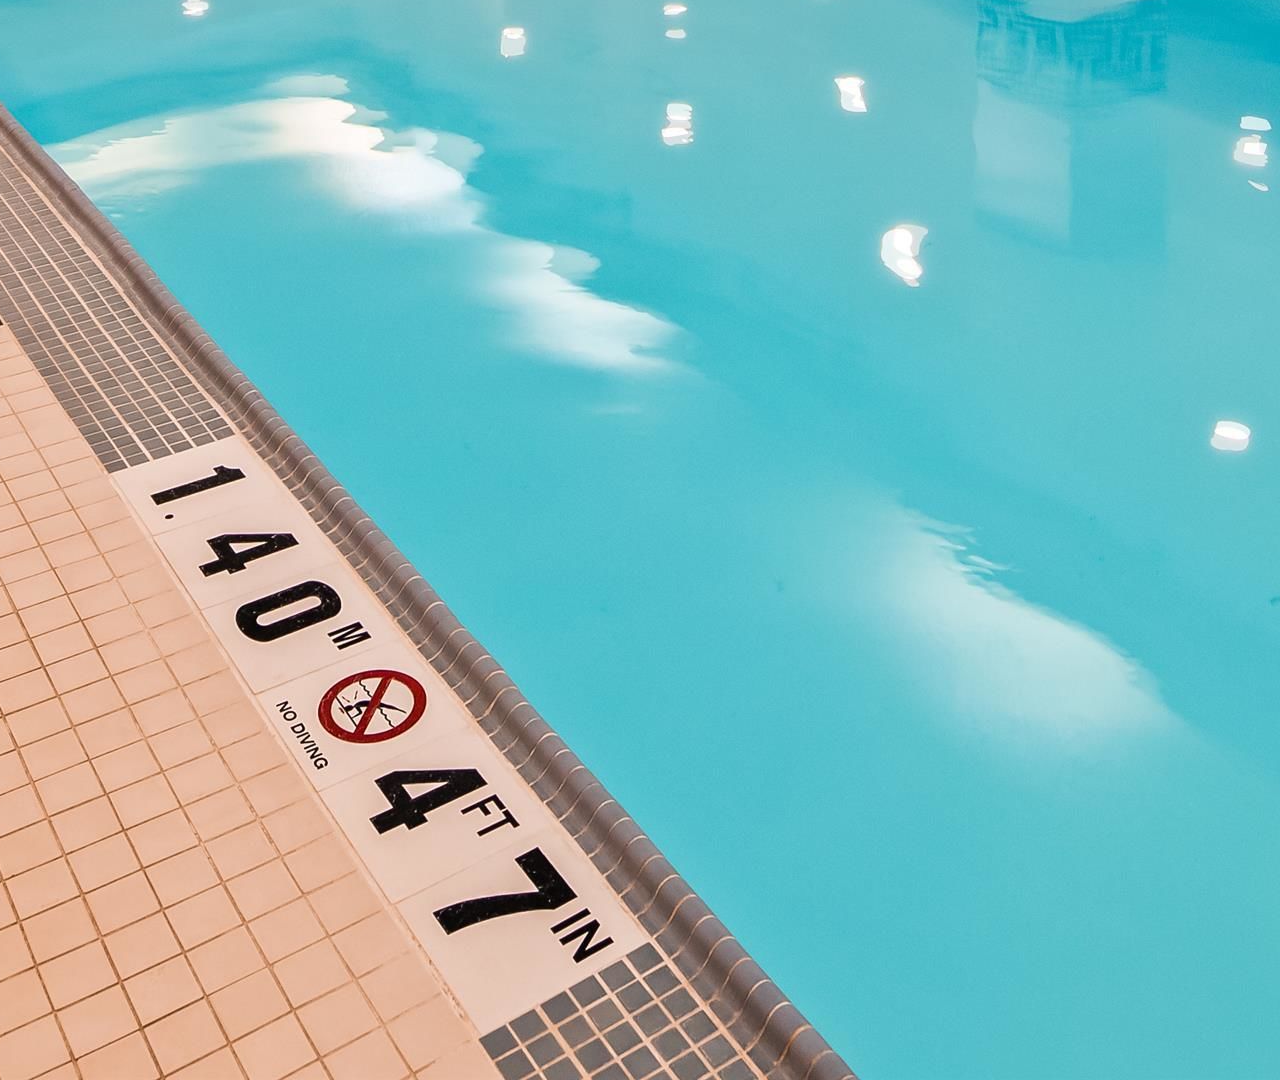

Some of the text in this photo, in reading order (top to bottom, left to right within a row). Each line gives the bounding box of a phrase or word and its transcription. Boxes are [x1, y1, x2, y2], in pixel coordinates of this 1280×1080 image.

[276, 700, 329, 770] NO DIVING
[460, 794, 520, 837] FT
[550, 907, 616, 964] IN
